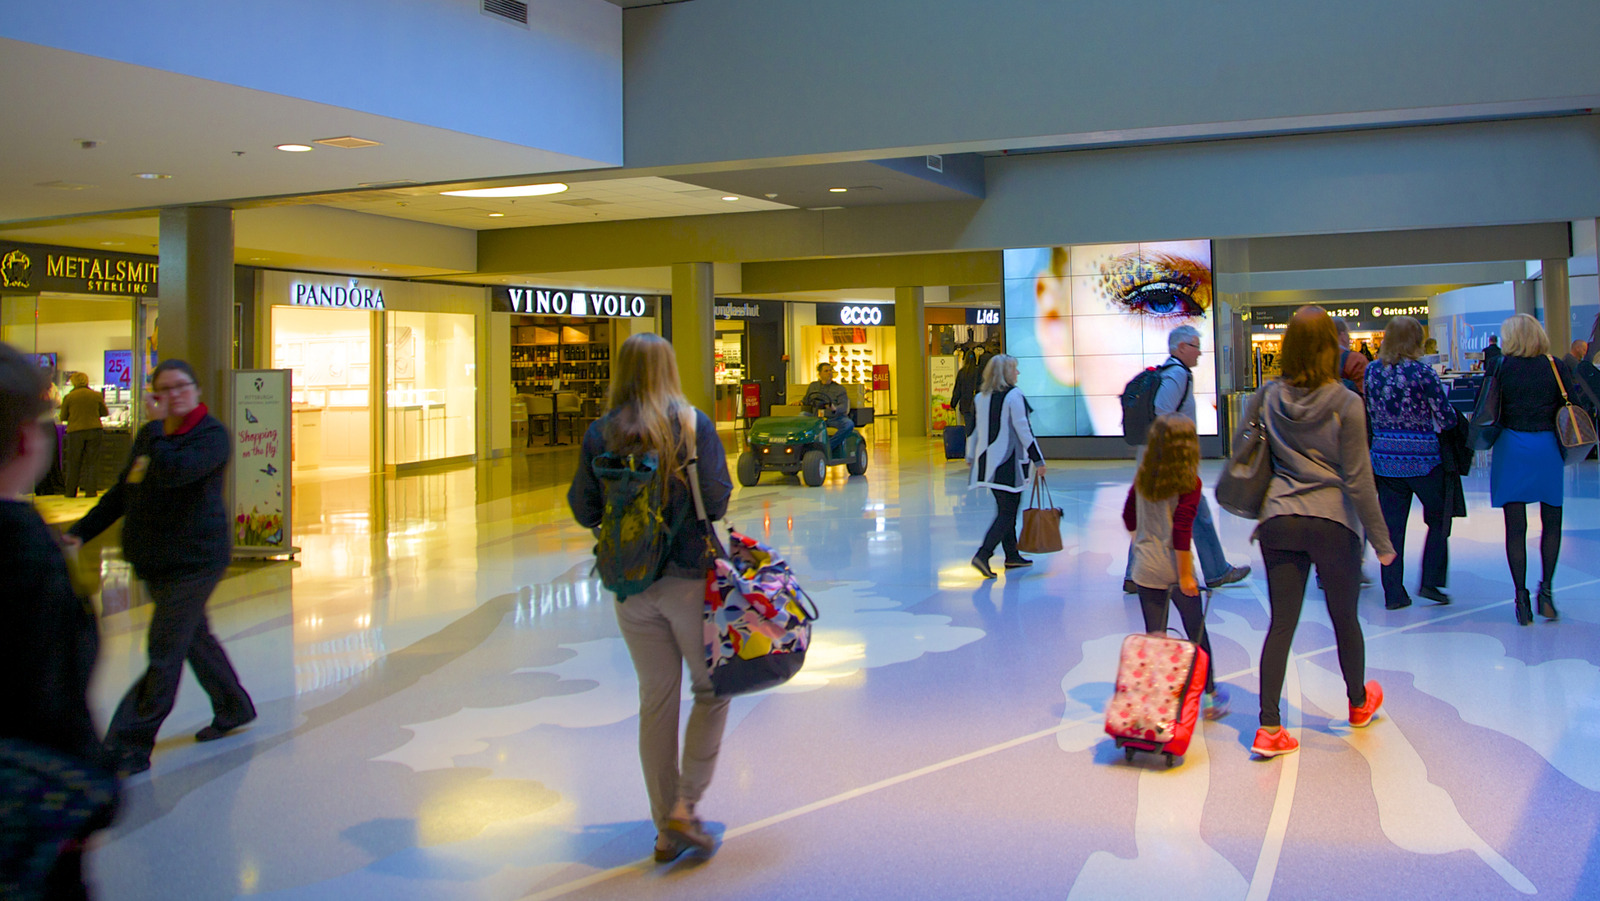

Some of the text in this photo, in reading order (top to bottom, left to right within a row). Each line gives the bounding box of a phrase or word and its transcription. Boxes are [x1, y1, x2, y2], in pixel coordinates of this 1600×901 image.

[87, 279, 148, 294] STERLING
[296, 283, 386, 309] PANDORA
[508, 288, 646, 317] VINO VOLO
[714, 302, 744, 320] unglass
[840, 305, 882, 325] ecco
[976, 309, 1000, 324] Lids
[1337, 308, 1360, 317] 26-50
[1383, 307, 1407, 316] Gates
[1408, 306, 1430, 315] 51-75
[108, 359, 122, 373] 25
[873, 373, 889, 382] SALE
